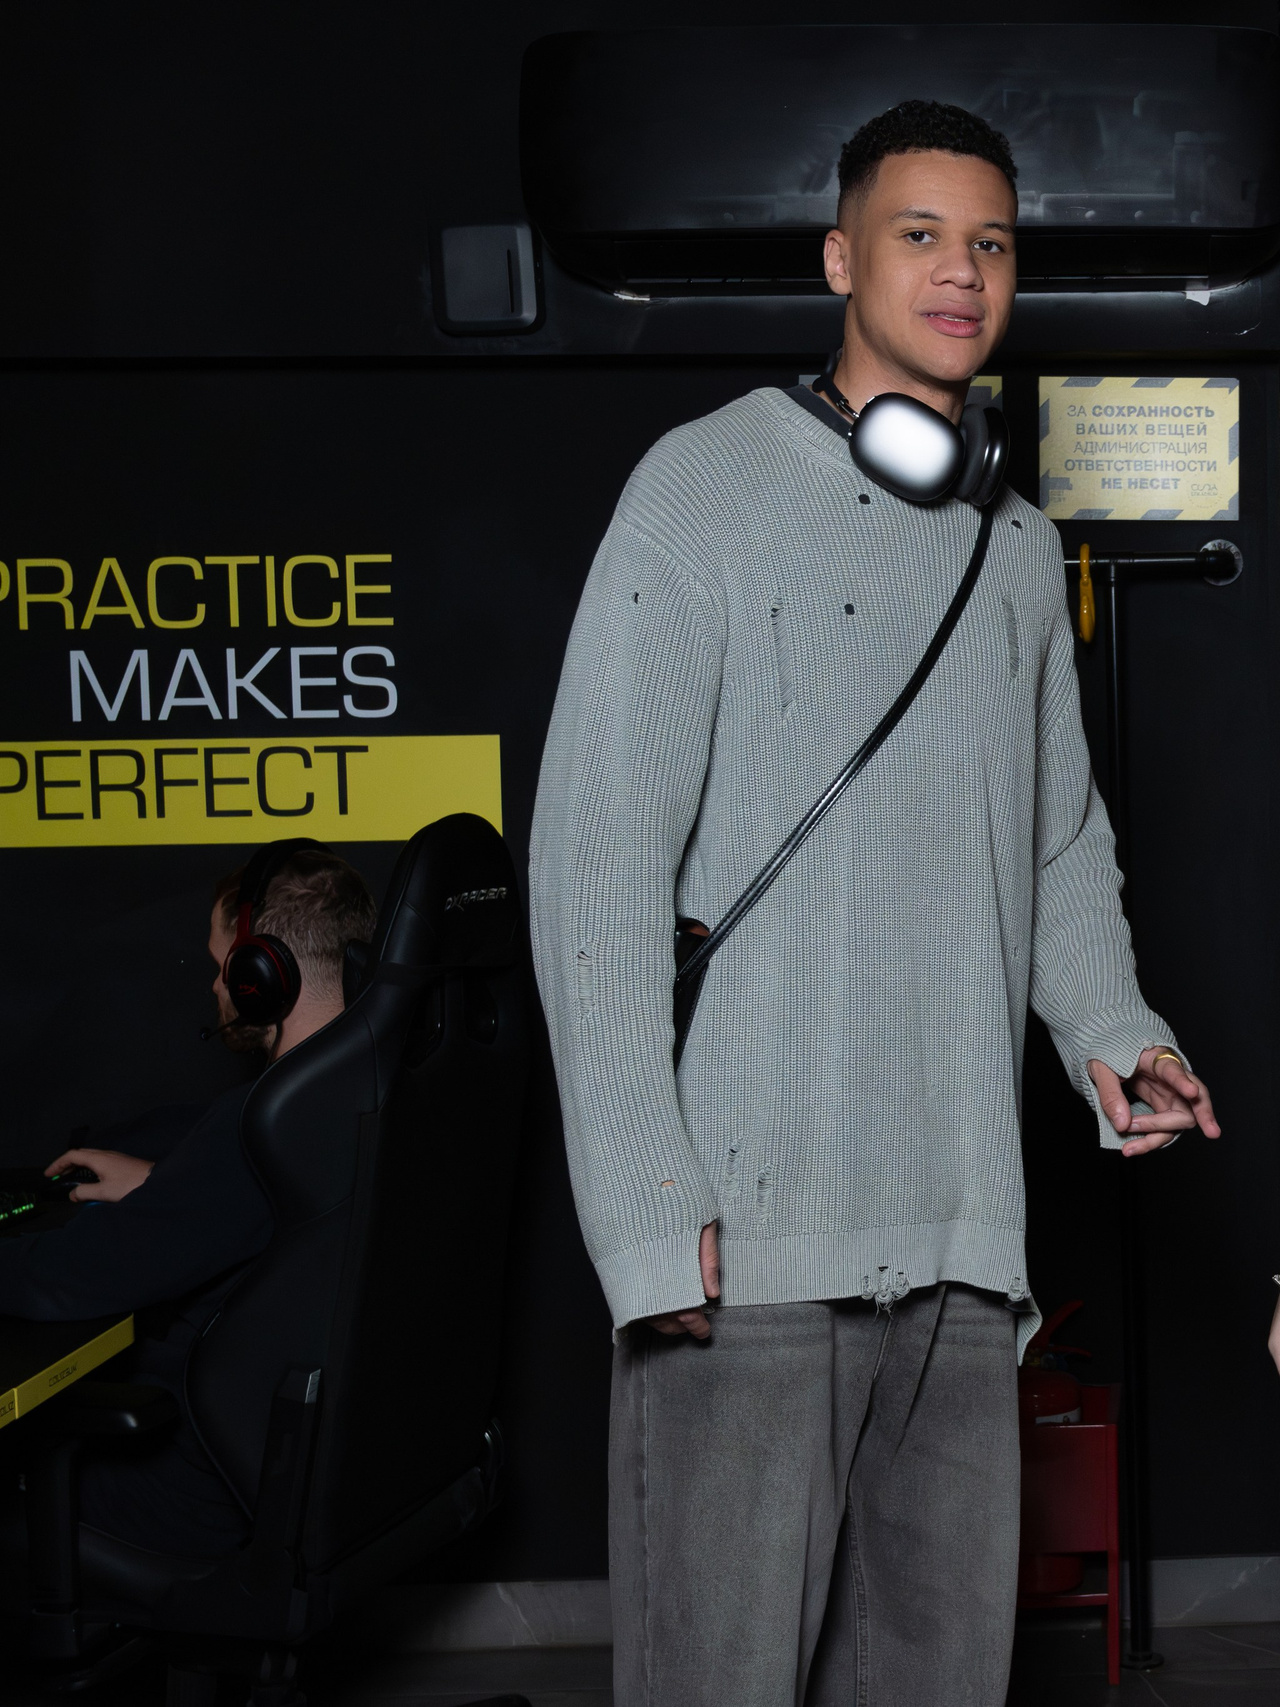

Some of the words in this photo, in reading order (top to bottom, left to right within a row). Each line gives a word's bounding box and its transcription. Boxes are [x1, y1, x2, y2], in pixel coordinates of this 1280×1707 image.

[1066, 405, 1087, 417] ЗА
[1091, 405, 1215, 418] СОХРАННОСТЬ
[1075, 423, 1138, 436] ВАШИХ
[1145, 421, 1207, 438] ВЕЩЕЙ
[1073, 441, 1208, 456] АДМИНИСТРАЦИЯ
[1064, 459, 1217, 472] ОТВЕТСТВЕННОСТИ
[1100, 477, 1123, 490] НЕ
[1127, 477, 1181, 490] НЕСЕТ
[0, 553, 394, 631] RACTICE
[69, 645, 398, 722] MAKES
